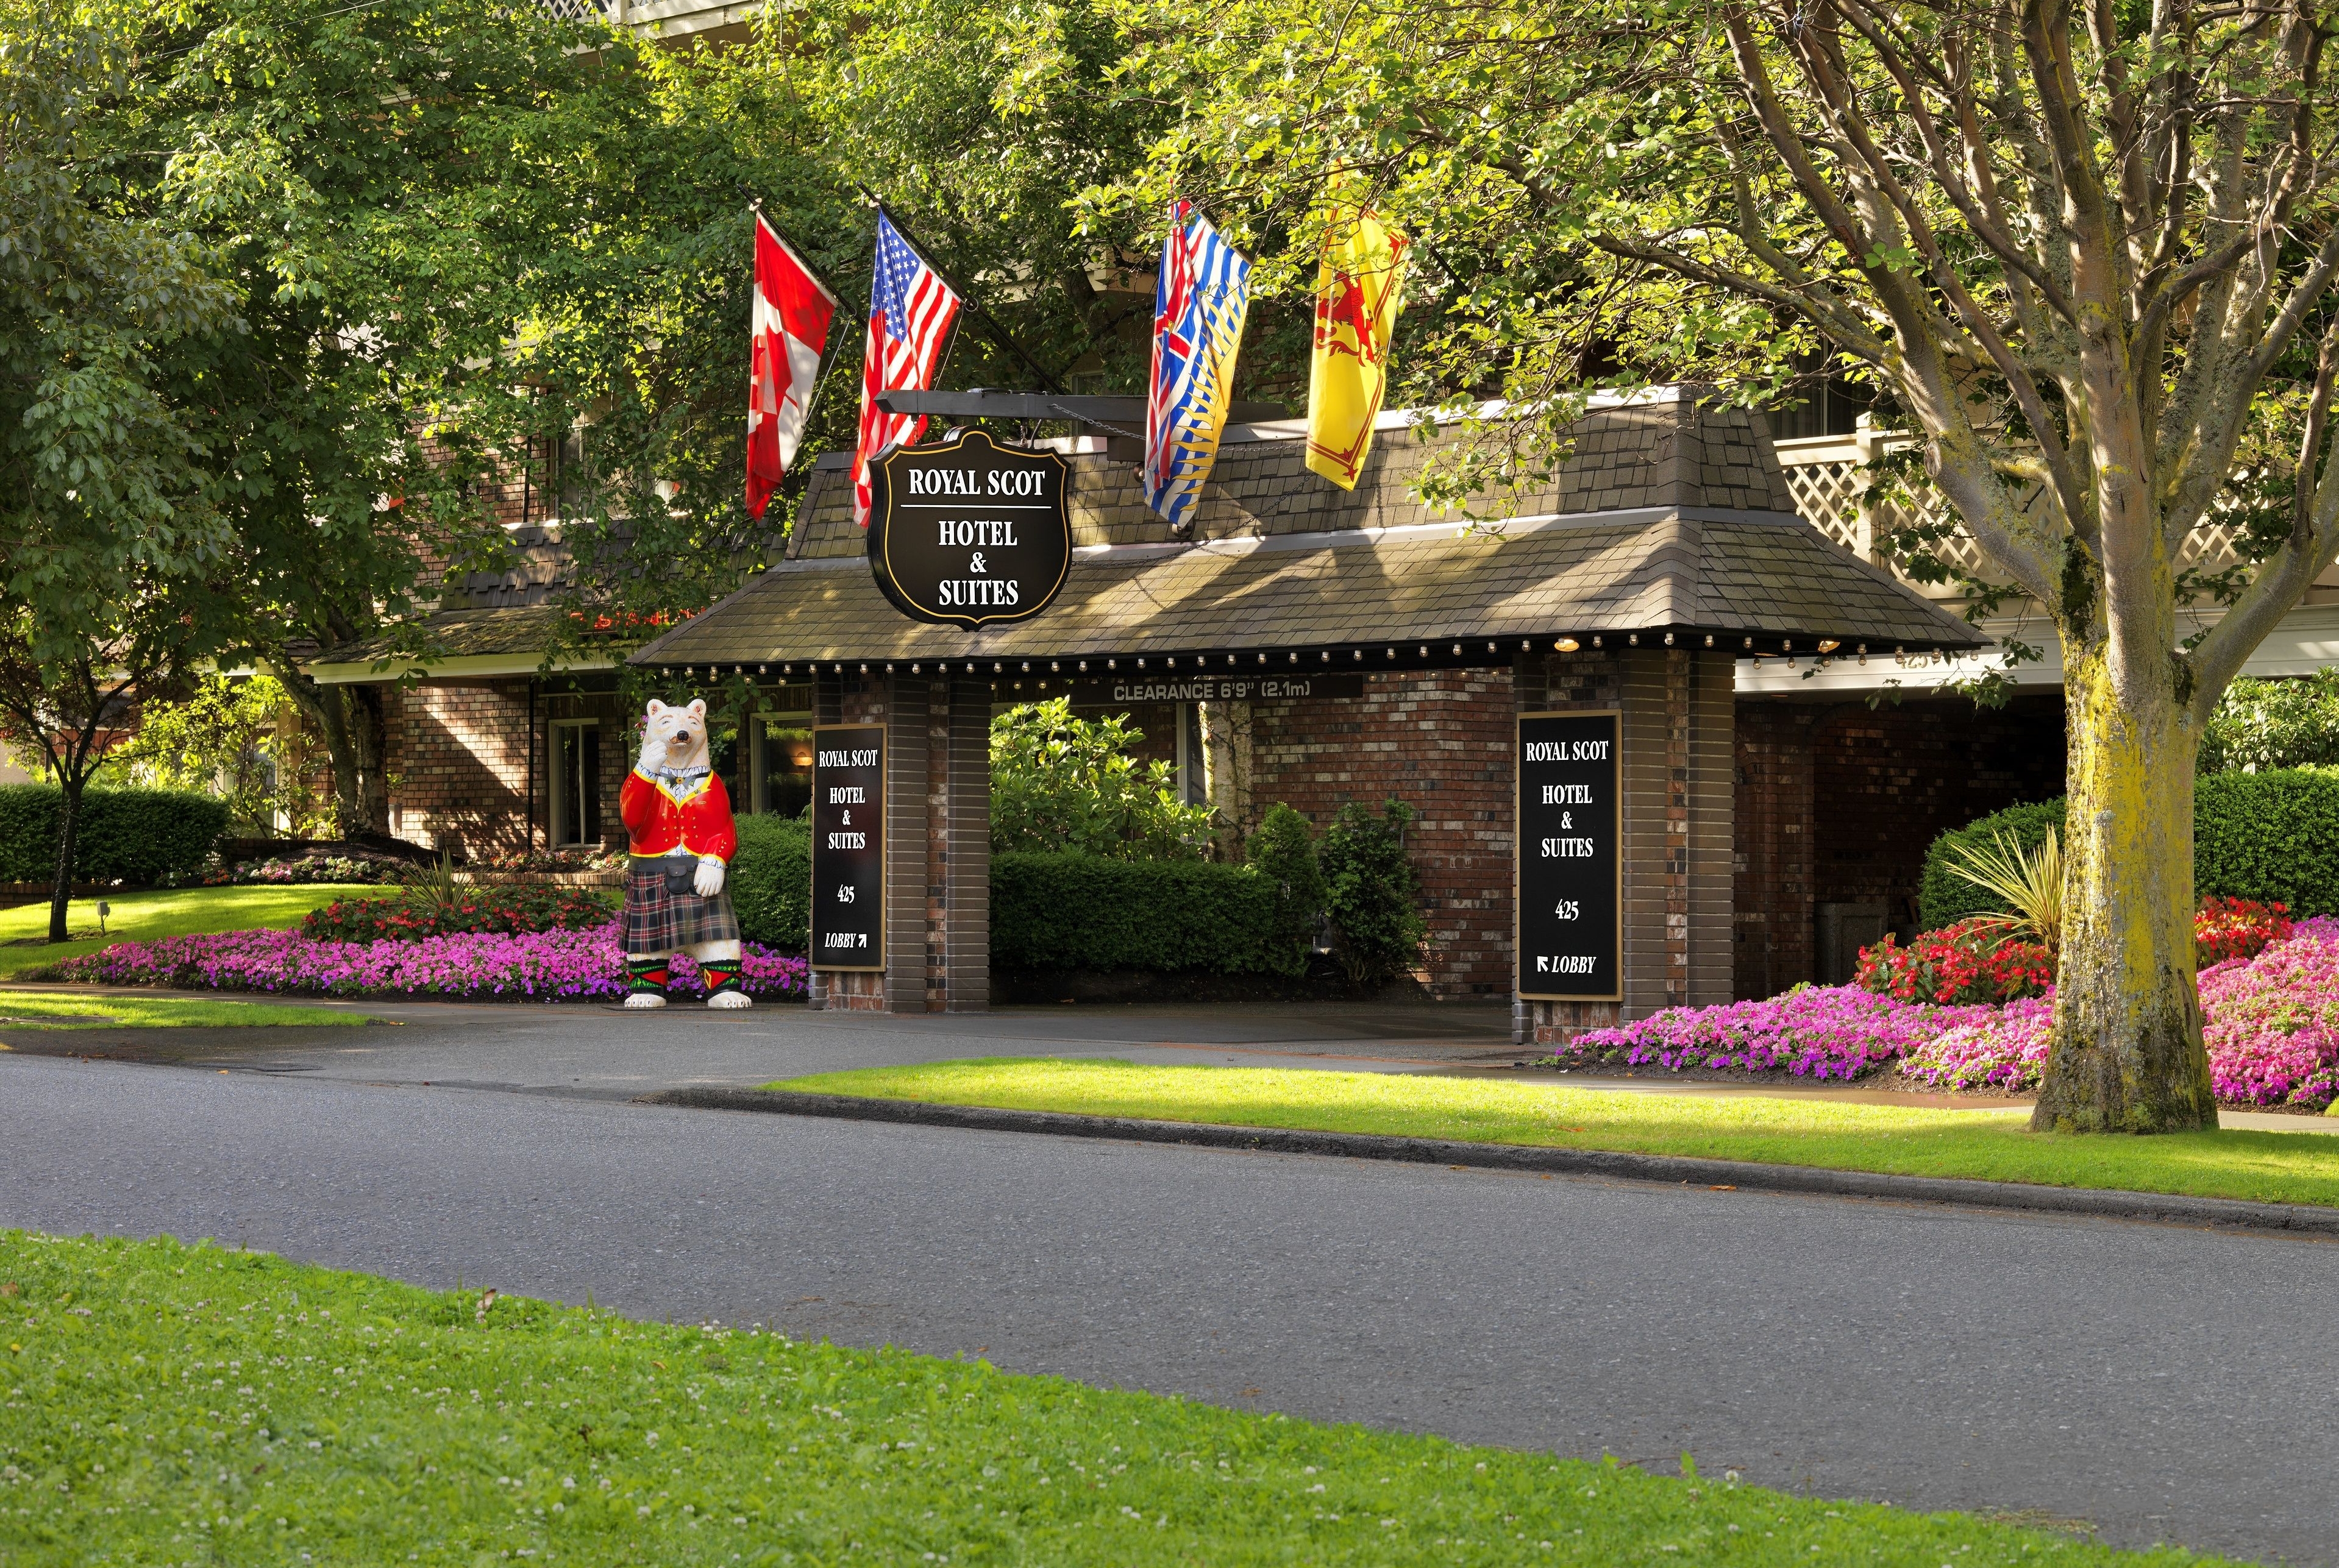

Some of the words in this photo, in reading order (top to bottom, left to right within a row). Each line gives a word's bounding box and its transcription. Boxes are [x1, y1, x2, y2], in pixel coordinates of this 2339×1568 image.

[908, 469, 981, 495] ROYAL
[987, 470, 1045, 496] SCOT
[938, 520, 1017, 546] HOTEL
[970, 552, 987, 573] &
[939, 579, 1019, 606] SUITES
[1114, 683, 1214, 701] CLEARANCE
[1261, 680, 1310, 697] (2.1m)
[819, 750, 849, 767] ROYAL
[852, 749, 878, 767] SCOT
[1526, 742, 1569, 762] ROYAL
[1572, 740, 1609, 761] SCOT
[829, 786, 866, 804] HOTEL
[1542, 784, 1593, 804] HOTEL
[842, 809, 851, 826] &
[1561, 811, 1573, 829] &
[828, 832, 866, 850] SUITES
[1541, 837, 1593, 857] SUITES
[837, 884, 855, 904] 425
[1555, 898, 1579, 921] 425
[824, 932, 856, 948] LOBBY
[1551, 956, 1597, 974] LOBBY
